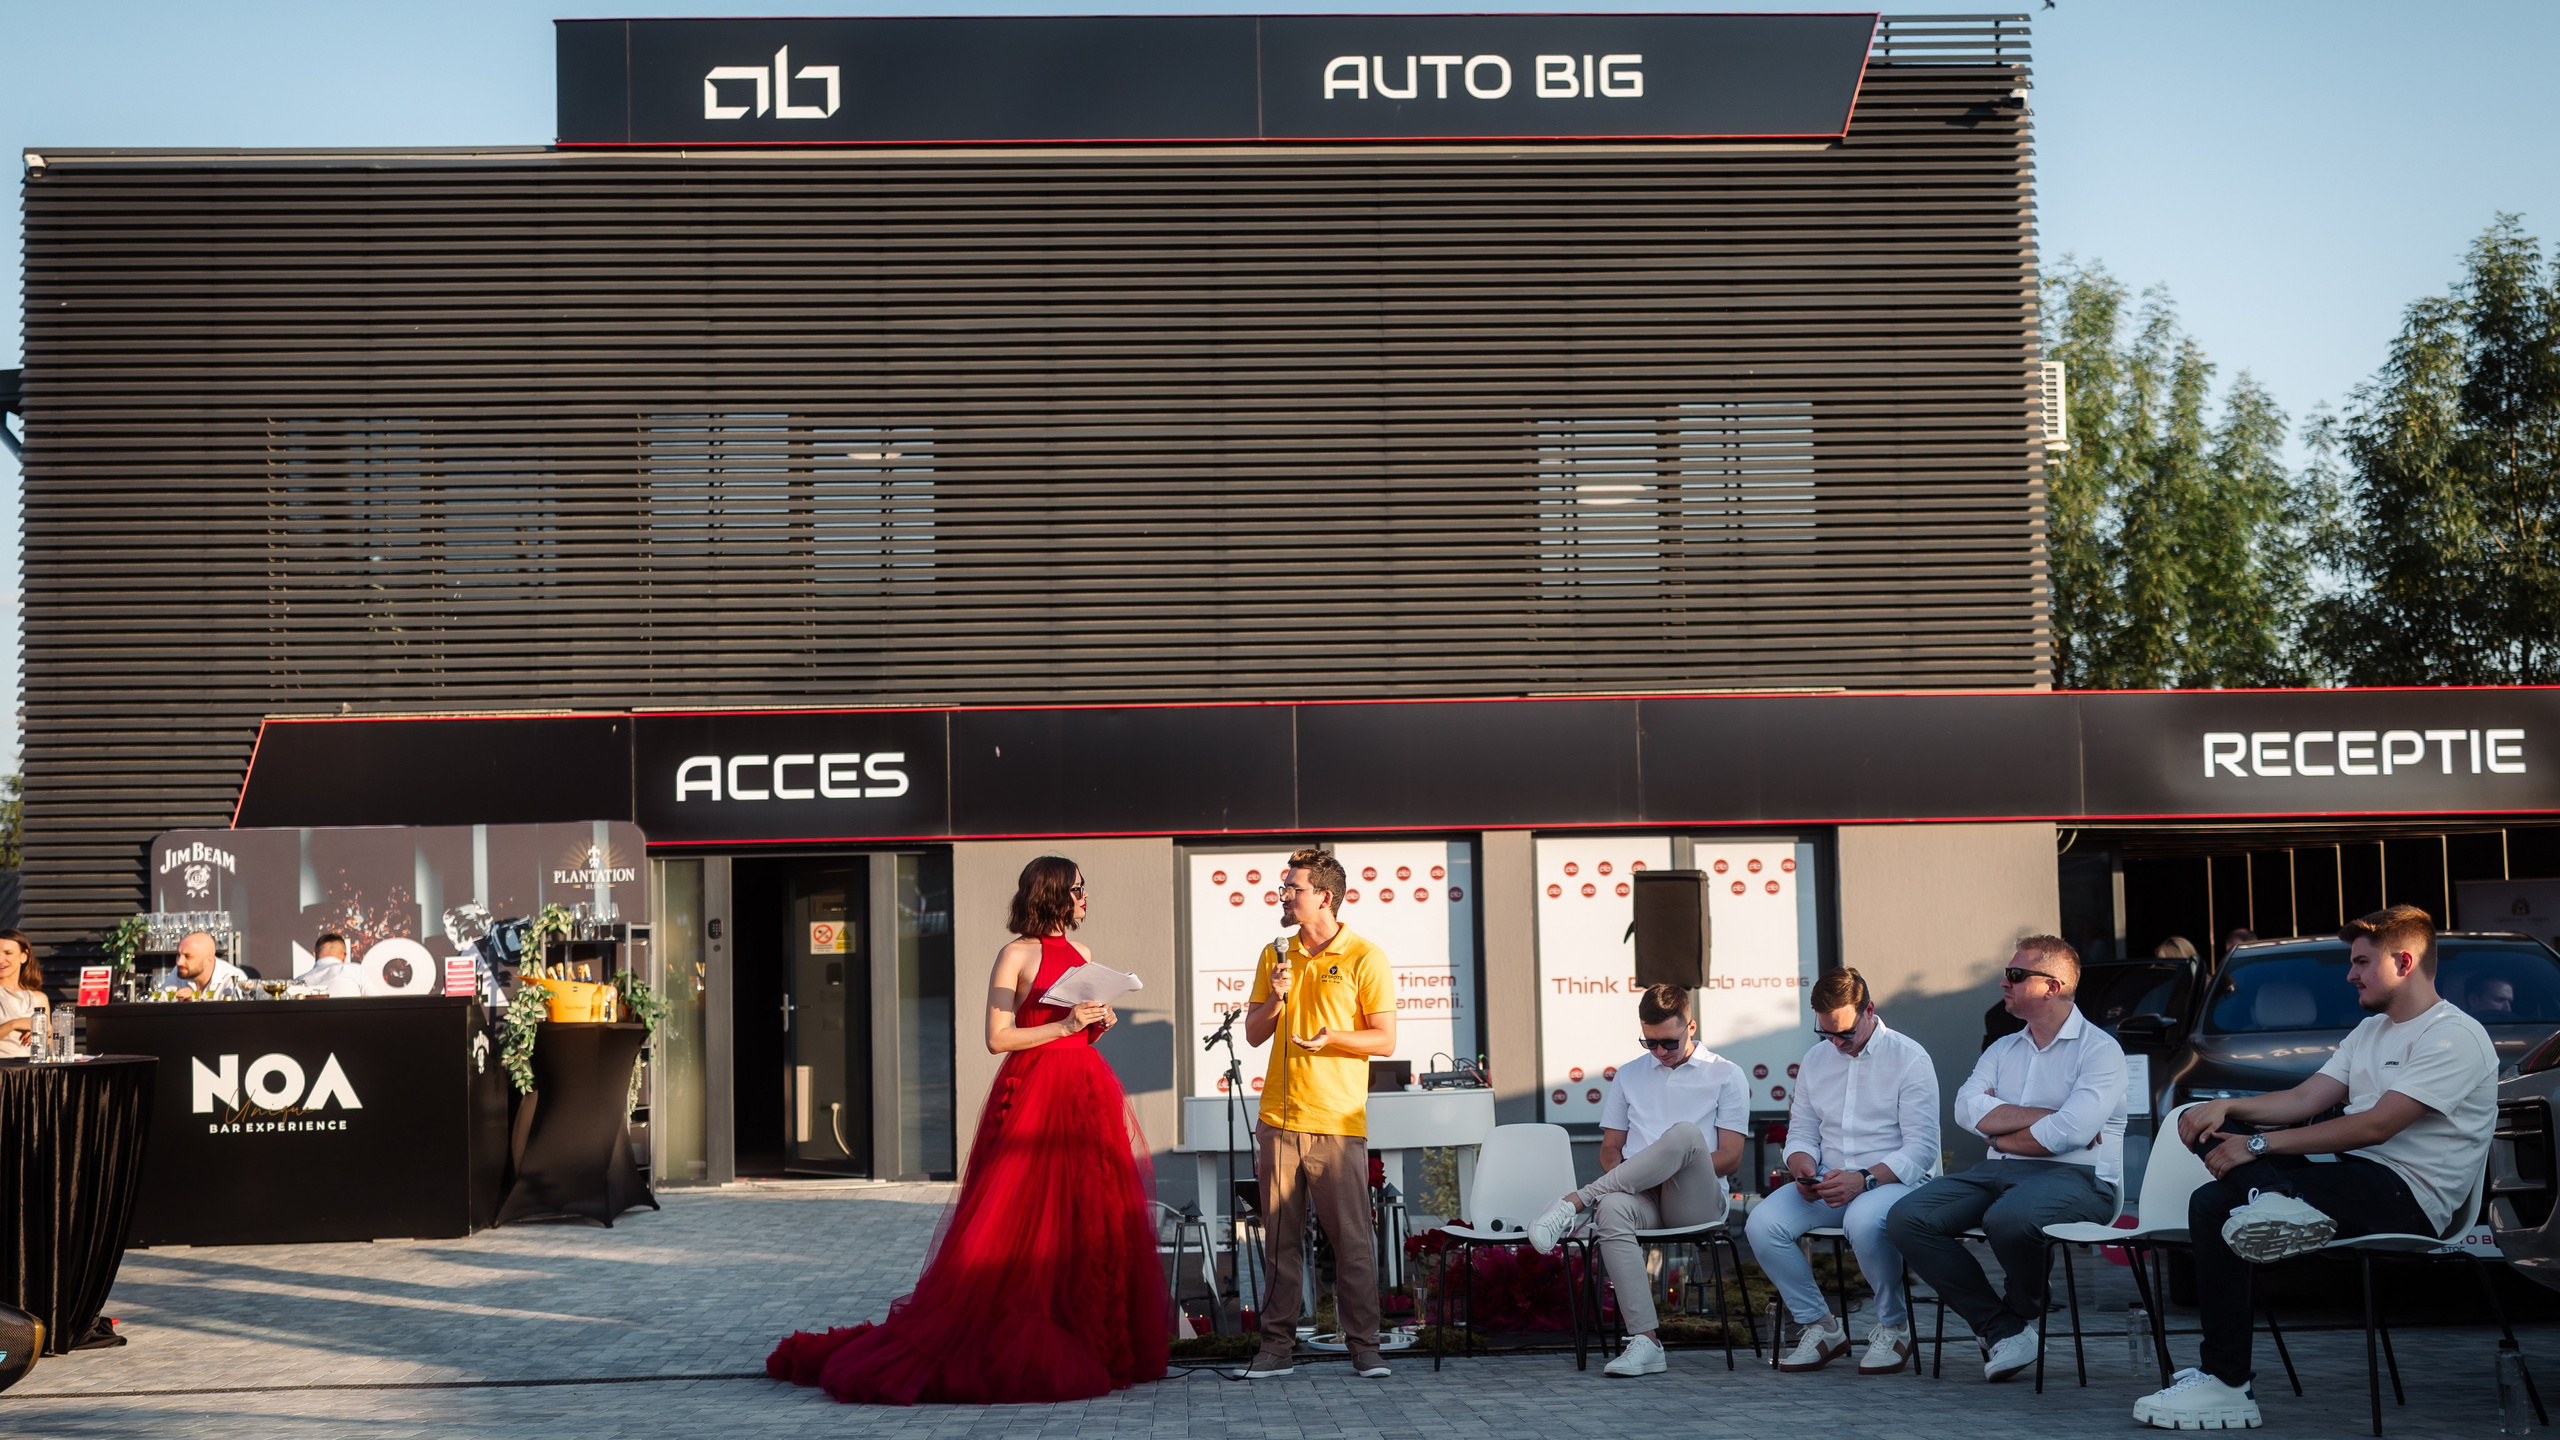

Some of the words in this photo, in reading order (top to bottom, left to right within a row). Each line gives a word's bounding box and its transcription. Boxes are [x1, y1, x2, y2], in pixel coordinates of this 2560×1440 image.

[704, 44, 840, 119] ab
[1324, 54, 1512, 99] AUTO
[1535, 54, 1643, 98] BIG
[2203, 728, 2526, 777] RECEPTIE
[676, 752, 909, 801] ACCES
[160, 848, 191, 875] JIM
[192, 841, 236, 876] BEAM
[553, 868, 635, 884] PLANTATION
[1217, 977, 1245, 991] Ne
[1551, 976, 1619, 994] Think
[1741, 977, 1782, 988] AUTO
[1785, 977, 1810, 988] BIG
[1395, 992, 1464, 1009] amenii.
[192, 1052, 363, 1113] NOA
[225, 1088, 318, 1124] Unique
[209, 1124, 240, 1134] BAR
[246, 1120, 347, 1133] EXPERIENCE
